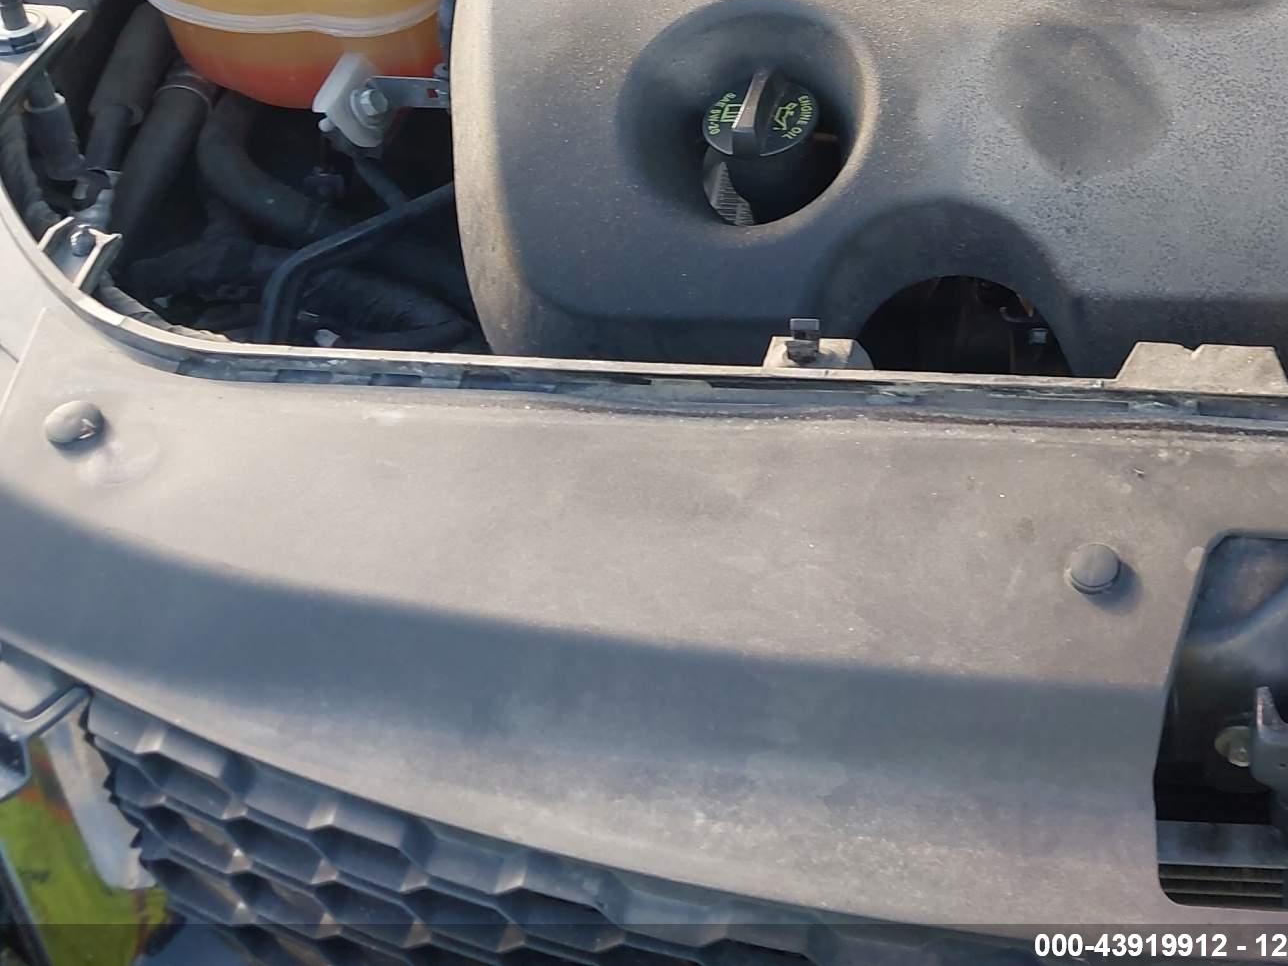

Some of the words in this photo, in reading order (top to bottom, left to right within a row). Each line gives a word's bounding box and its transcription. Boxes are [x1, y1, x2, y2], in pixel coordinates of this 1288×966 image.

[719, 92, 737, 108] SAE
[797, 95, 813, 125] ENGINE
[708, 109, 721, 135] 5W-20
[781, 126, 803, 140] OIL
